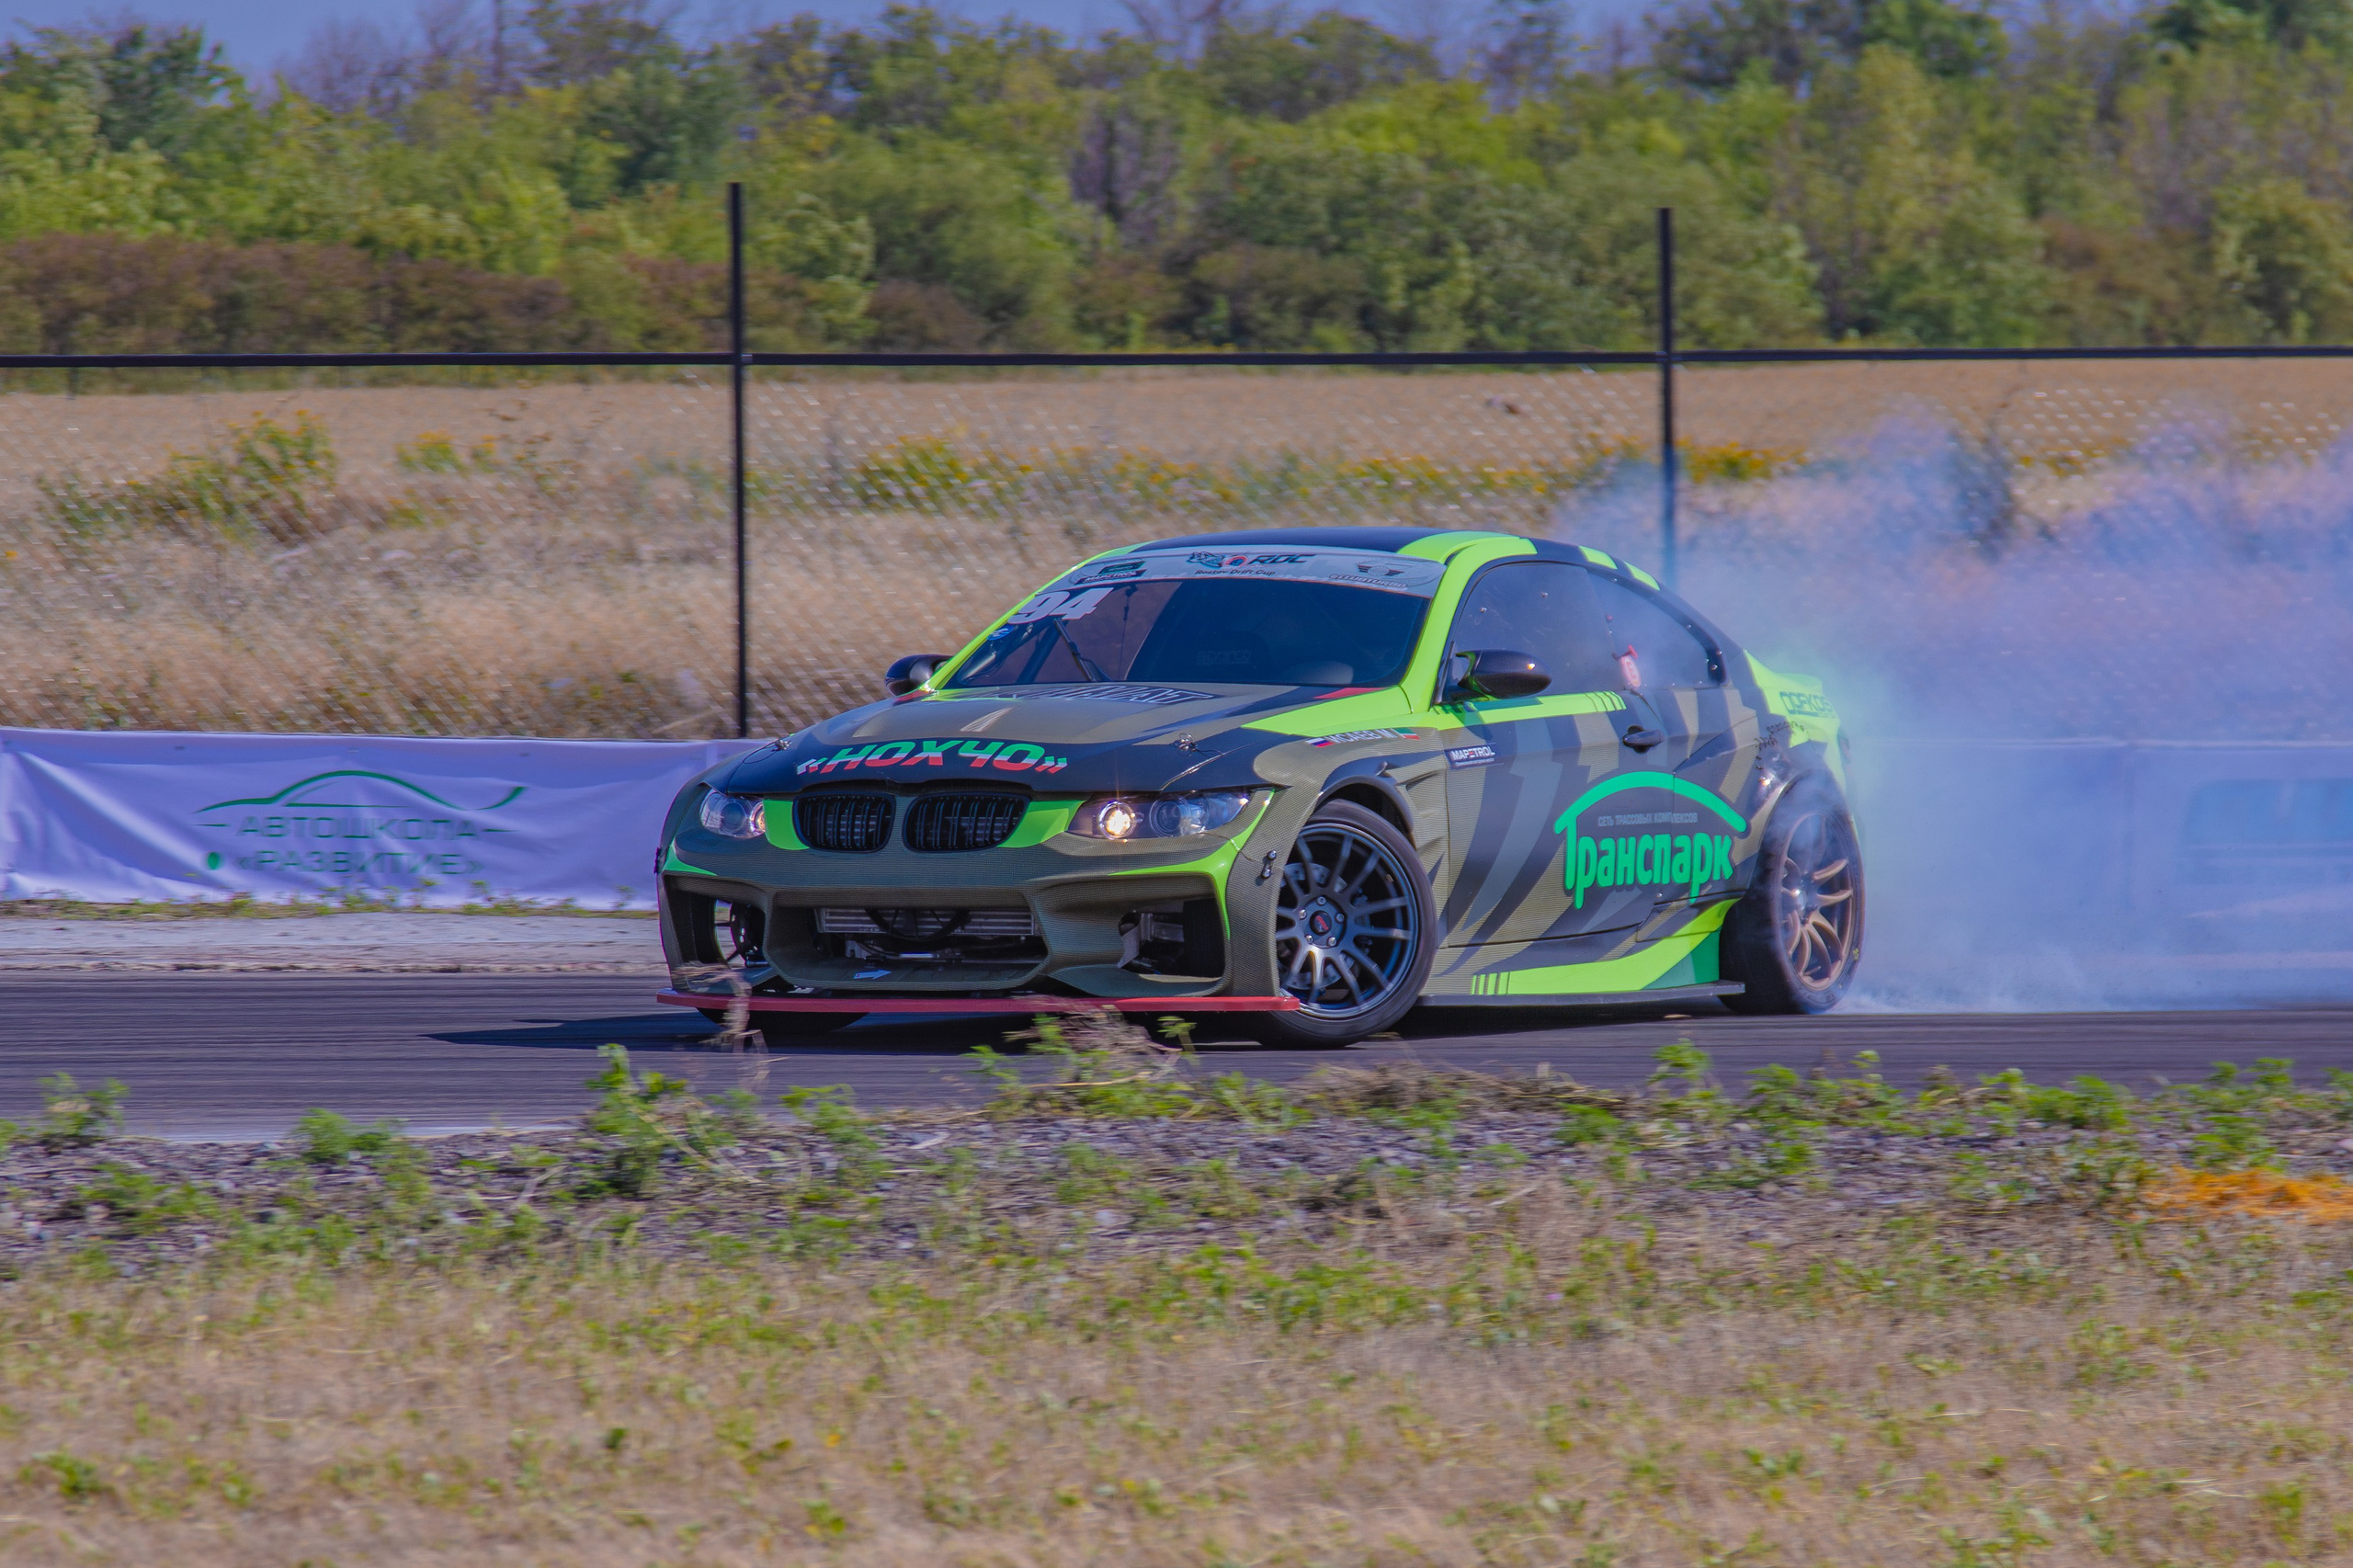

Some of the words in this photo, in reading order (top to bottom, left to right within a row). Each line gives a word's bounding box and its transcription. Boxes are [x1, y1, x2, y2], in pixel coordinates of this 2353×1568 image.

[1007, 587, 1114, 624] 94
[1451, 745, 1495, 760] MAPETROL
[236, 816, 478, 840] АВТОШКОЛА
[1597, 815, 1614, 826] СЕТЬ
[1615, 813, 1653, 825] ТРАССОВЫХ
[1654, 812, 1699, 824] КОМПЛЕКСОВ
[1561, 813, 1733, 910] Транспарк
